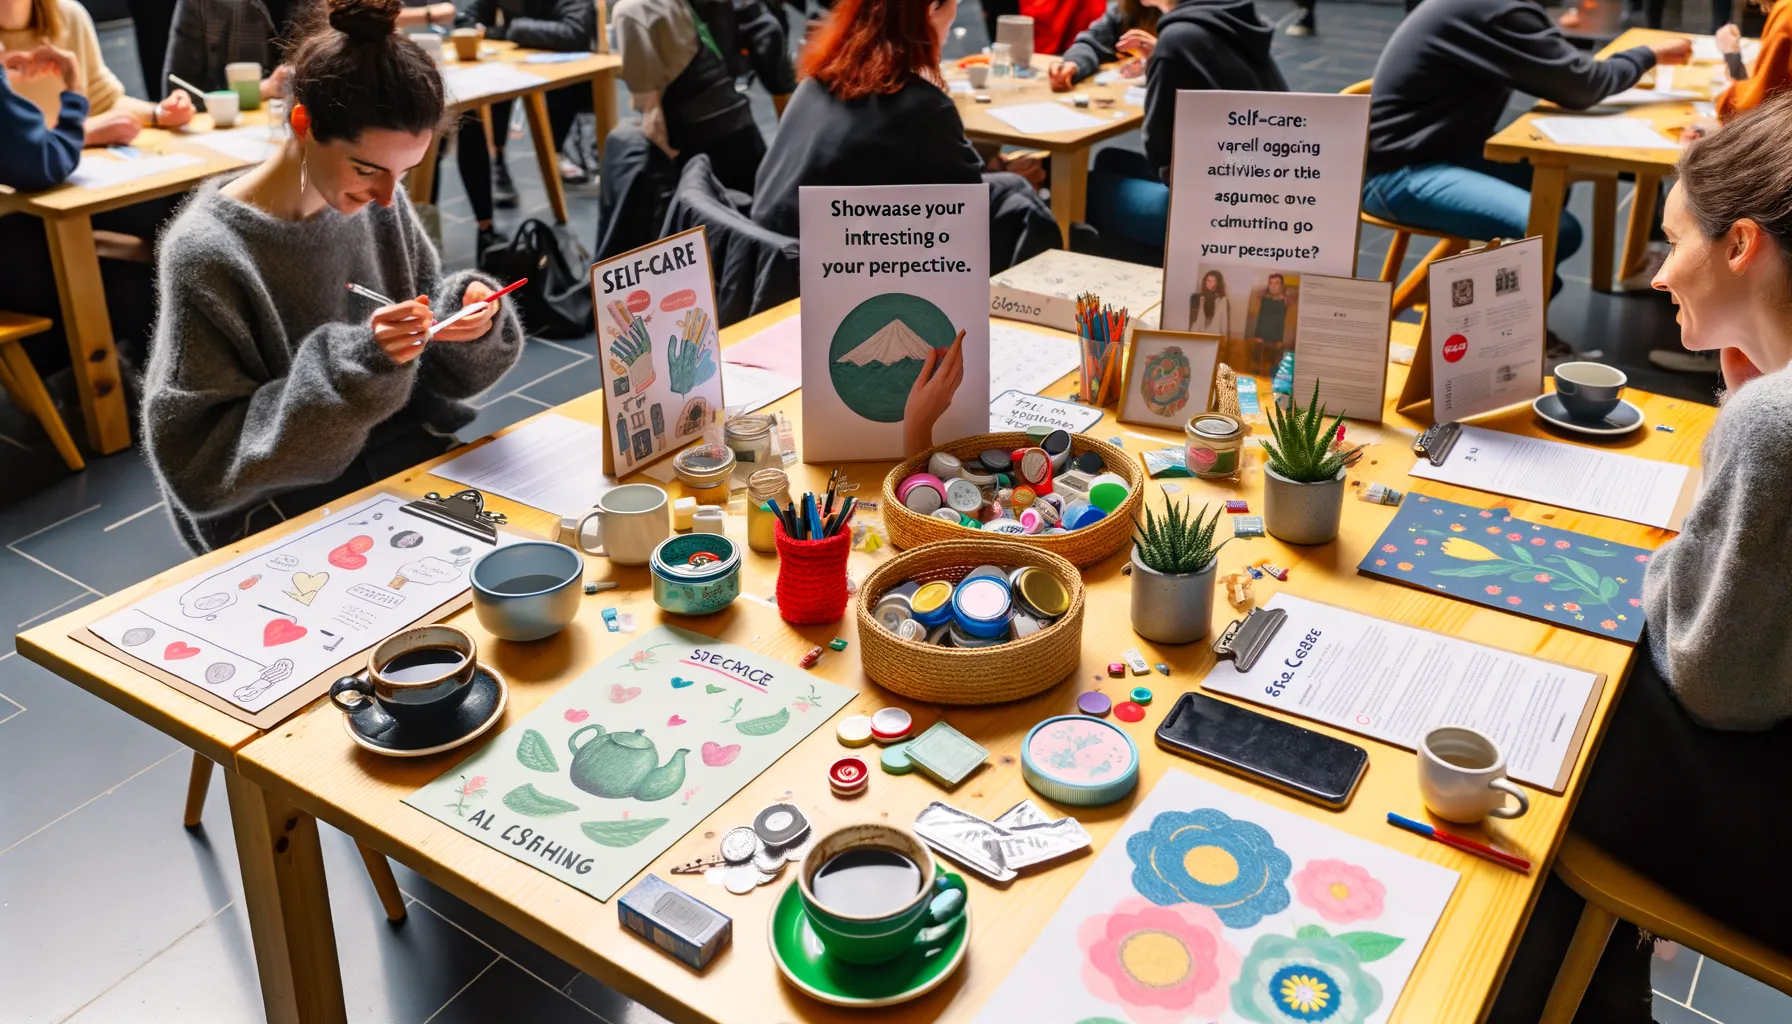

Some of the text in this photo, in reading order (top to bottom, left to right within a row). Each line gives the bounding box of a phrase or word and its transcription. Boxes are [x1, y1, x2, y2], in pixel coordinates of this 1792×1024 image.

[1228, 109, 1307, 128] Self-care:
[1273, 167, 1290, 178] or
[925, 202, 965, 219] your
[1293, 220, 1313, 235] go
[938, 231, 950, 244] o
[602, 241, 697, 294] SELF-CARE
[822, 256, 972, 278] your perpective.
